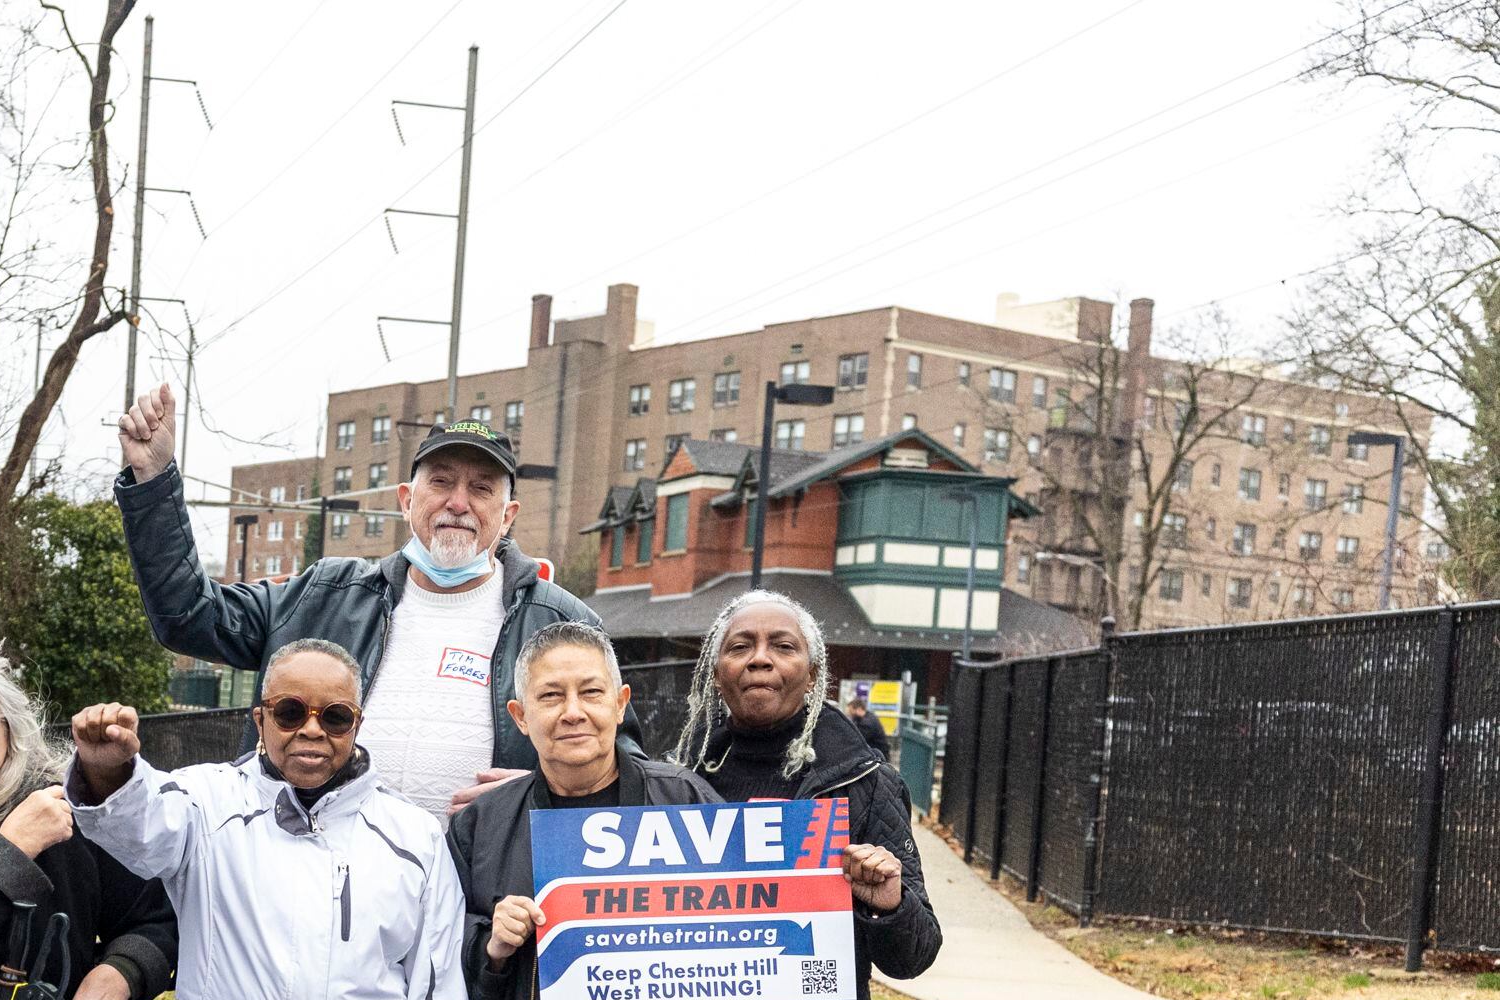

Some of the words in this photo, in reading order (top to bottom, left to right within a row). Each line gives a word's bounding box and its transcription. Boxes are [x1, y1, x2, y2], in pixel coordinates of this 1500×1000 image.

[449, 651, 474, 665] TIM
[581, 806, 785, 869] SAVE
[583, 887, 650, 914] THE
[662, 883, 779, 911] TRAIN
[584, 925, 778, 947] savethetrain.org
[587, 965, 642, 984] Keep
[648, 962, 737, 980] Chestnut
[744, 958, 778, 976] Hill
[587, 985, 641, 1000] West
[648, 980, 762, 999] RUNNING!
